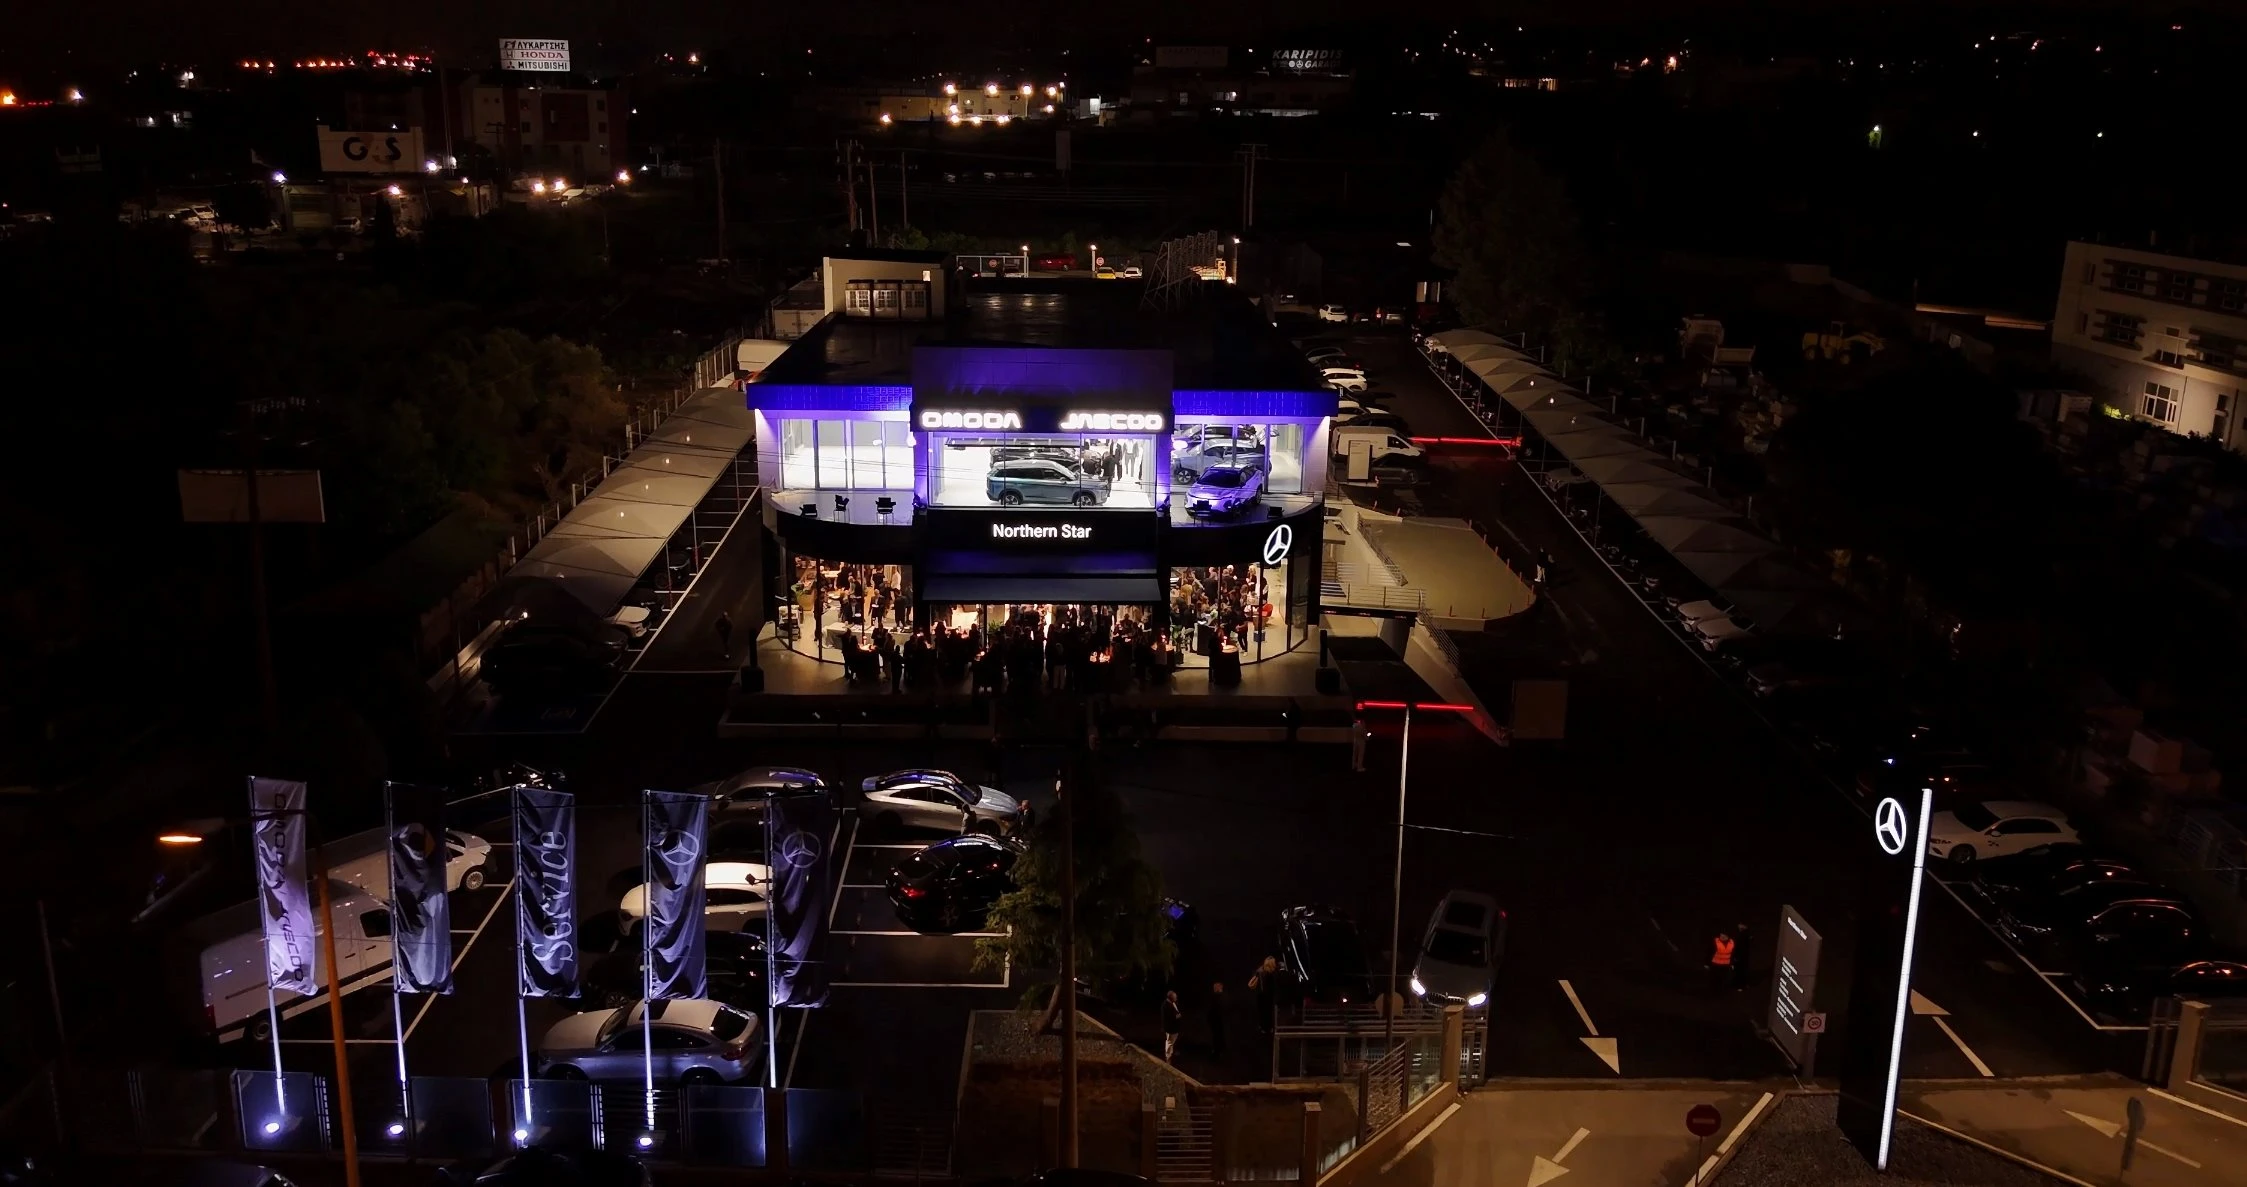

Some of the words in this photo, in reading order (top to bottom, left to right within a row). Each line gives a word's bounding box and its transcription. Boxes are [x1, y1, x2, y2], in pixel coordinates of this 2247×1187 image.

[518, 41, 565, 50] ΛΥΚΑΡΤΣΗΣ
[521, 51, 564, 59] HONDA
[1272, 49, 1344, 60] KARIPIDIS
[518, 61, 567, 70] MITSUBISHI
[922, 412, 1021, 428] OMODA
[993, 523, 1058, 539] Northern
[1061, 523, 1092, 539] Star
[532, 831, 574, 962] Service
